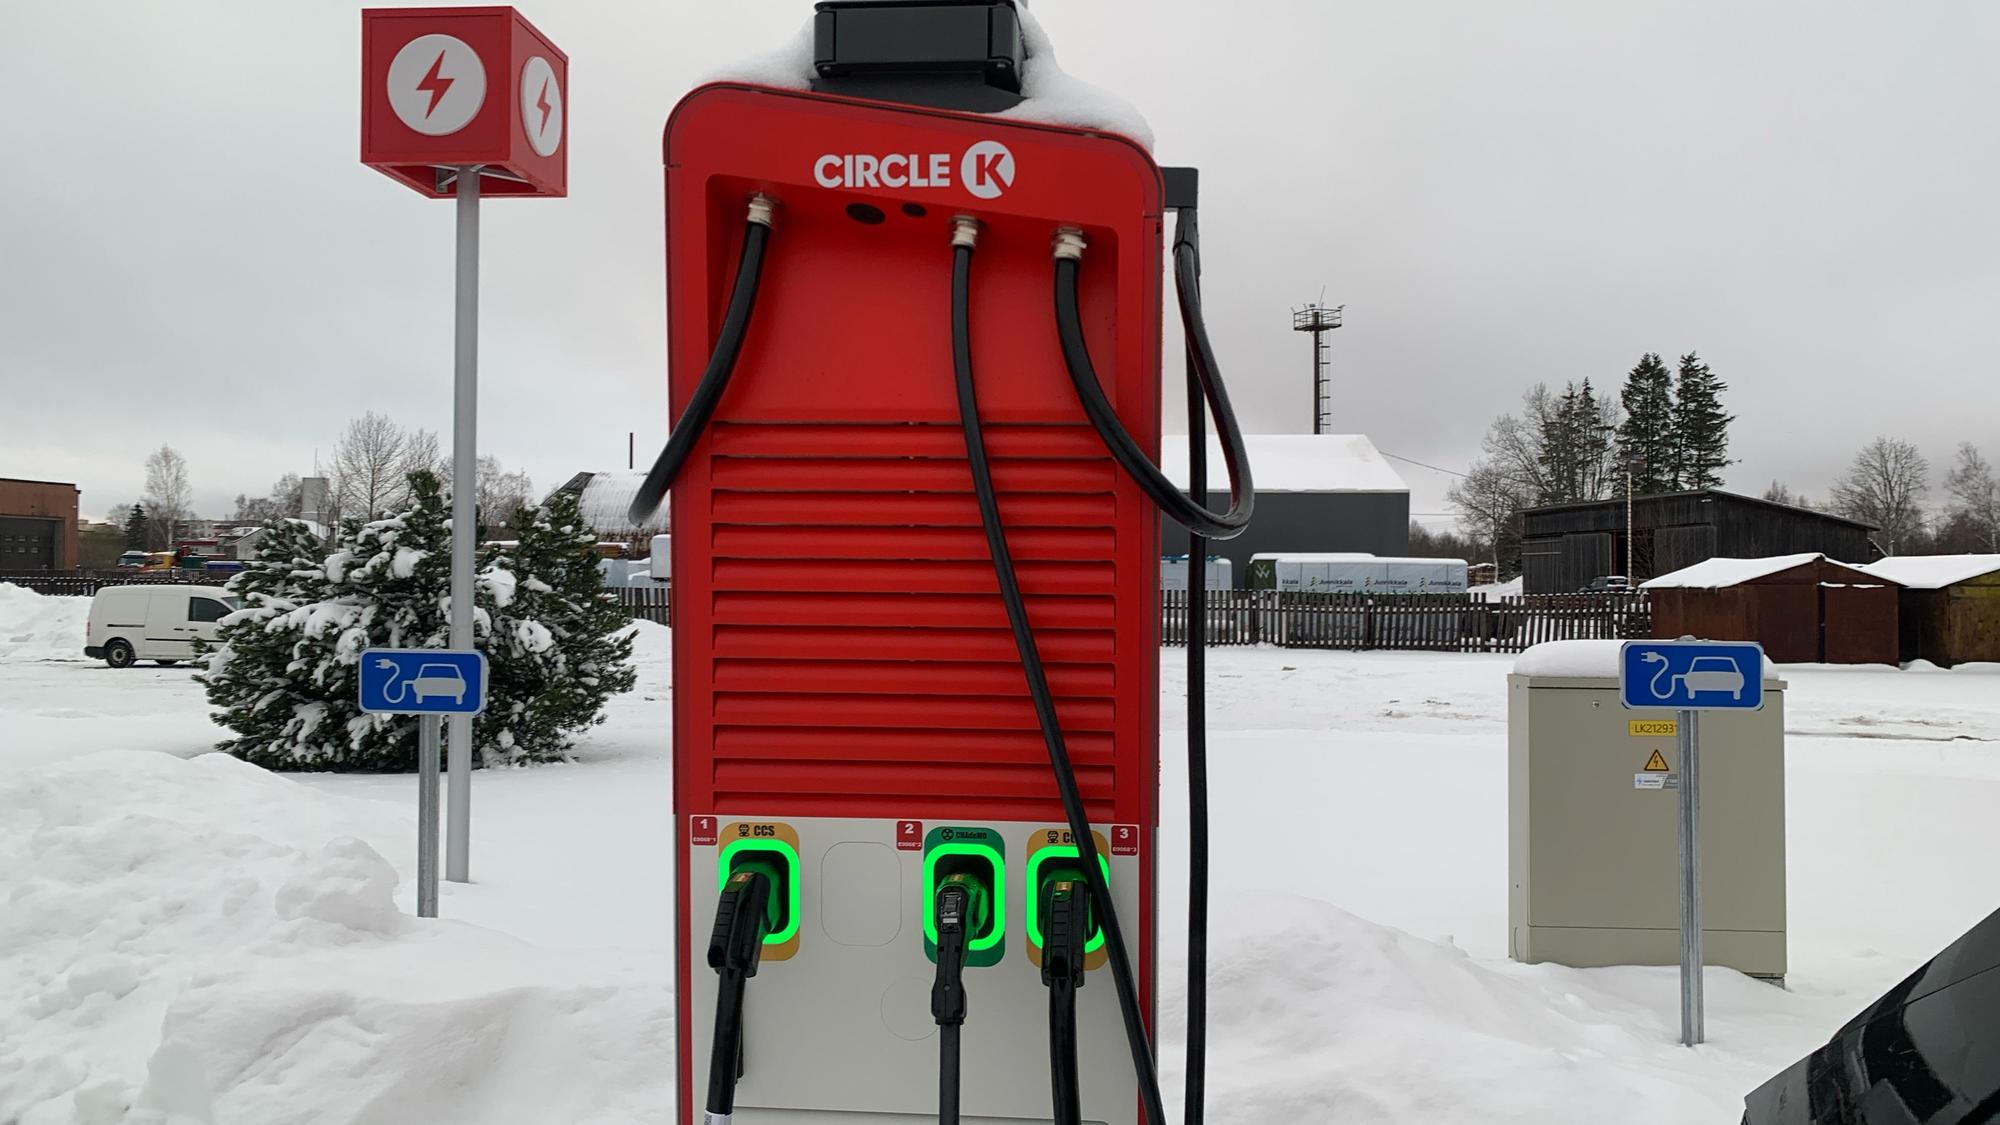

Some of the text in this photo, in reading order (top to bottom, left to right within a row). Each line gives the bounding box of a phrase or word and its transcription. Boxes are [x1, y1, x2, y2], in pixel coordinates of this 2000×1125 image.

[813, 148, 1014, 198] CIRCLE K
[1634, 723, 1678, 734] LK21293
[700, 818, 708, 829] 1
[904, 823, 914, 834] 2
[753, 825, 775, 837] CCS
[1119, 828, 1129, 839] 3
